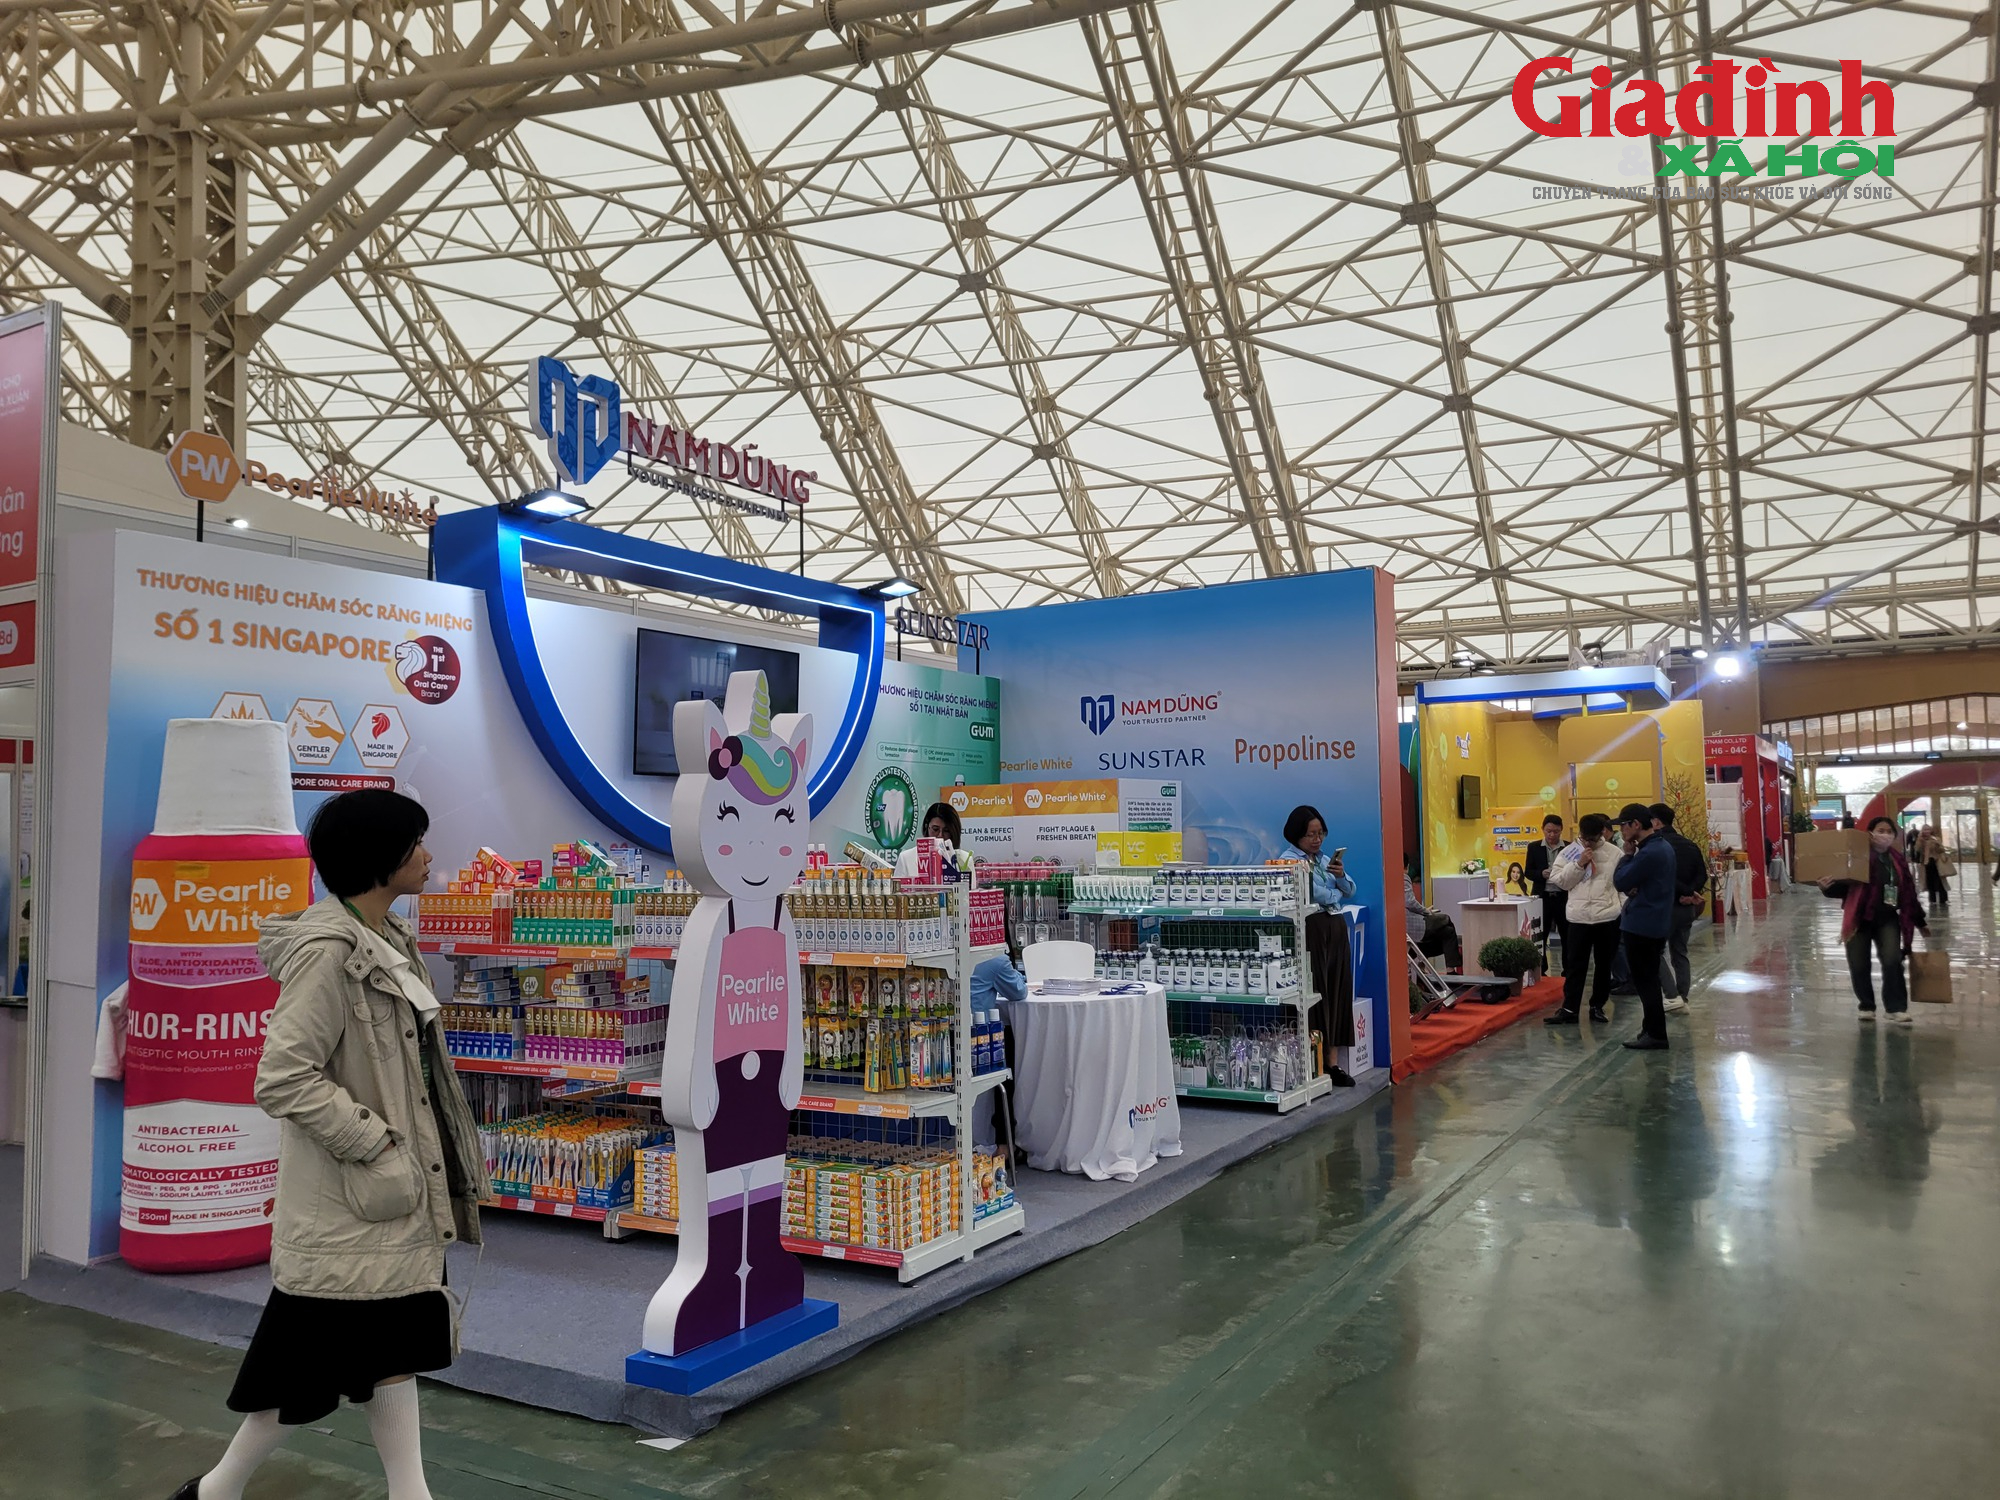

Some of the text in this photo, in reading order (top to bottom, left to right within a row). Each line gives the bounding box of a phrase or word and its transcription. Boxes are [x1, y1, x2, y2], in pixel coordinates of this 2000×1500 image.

[181, 448, 438, 527] PW Pearlie White
[630, 466, 792, 524] YOUR TRUSTED PARTNER
[137, 568, 474, 633] THƯƠNG HIỆU CHĂM SÓC RĂNG MIỆNG
[153, 607, 392, 663] SỐ 1 SINGAPORE
[894, 606, 991, 651] SUNSTAR
[433, 646, 444, 654] THE
[423, 671, 457, 682] Singapore
[413, 680, 449, 691] Oral Care
[420, 689, 440, 699] Brand
[907, 687, 923, 702] HIỆU
[924, 689, 945, 702] CHĂM
[945, 692, 958, 705] SÓC
[959, 694, 978, 708] RĂNG
[909, 700, 919, 713] SỐ
[924, 705, 935, 717] TẠI
[936, 706, 954, 719] NHẬT
[1142, 717, 1173, 725] TRUSTED
[1175, 714, 1207, 722] PARTNER
[296, 744, 330, 753] GENTLER
[1234, 734, 1357, 770] Propolinse
[362, 751, 398, 760] SINGAPORE
[1098, 747, 1206, 771] SUNSTAR
[1000, 758, 1039, 772] Pearlie
[1040, 757, 1071, 770] White
[317, 778, 340, 788] ORAL
[341, 779, 362, 789] CARE
[363, 780, 390, 789] BRAND
[865, 768, 889, 833] SCIENTIFICALLY
[889, 767, 910, 785] TESTED
[951, 795, 1006, 806] PW Pearlie
[1026, 791, 1106, 804] PW Pearlie White
[1036, 833, 1096, 842] FRESHEN BREATH
[132, 873, 292, 916] PW Pearlie
[166, 957, 257, 967] ANTIOXIDANTS,
[138, 967, 194, 976] CHAMOMILE
[209, 967, 259, 977] XYLITOL
[721, 968, 785, 998] Pearlie
[727, 998, 779, 1026] White
[177, 1048, 230, 1060] MOUTH
[137, 1124, 240, 1136] ANTIBACTERIAL
[137, 1141, 236, 1153] ALCOHOL FREE
[229, 1162, 278, 1178] TESTED
[230, 1175, 278, 1188] PHTHALATES
[225, 1186, 259, 1195] SULFATE
[140, 1213, 168, 1221] 250ml
[211, 1207, 262, 1218] SINGAPORE
